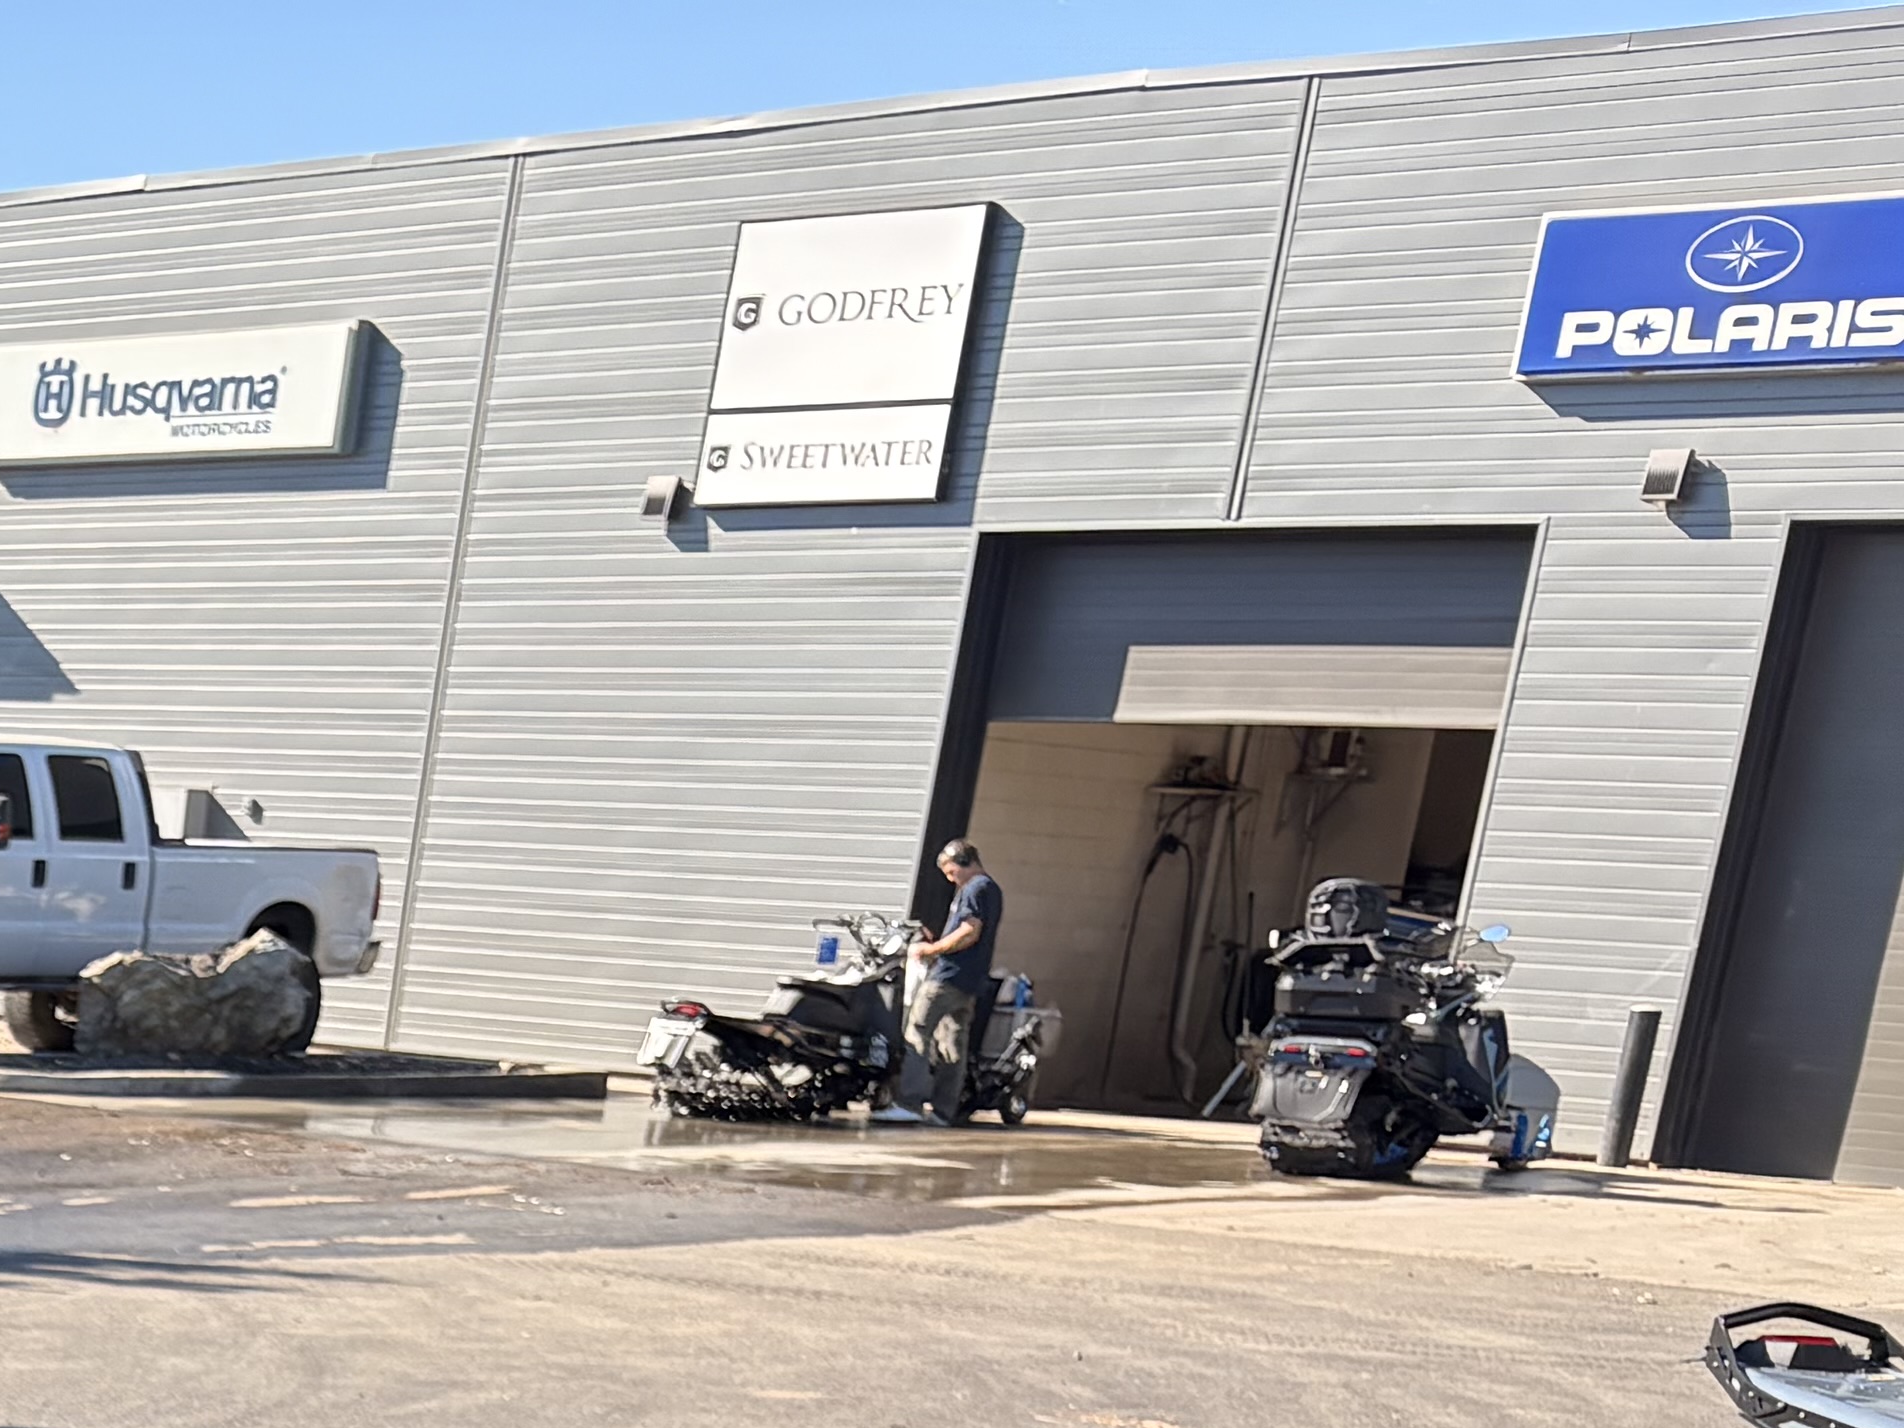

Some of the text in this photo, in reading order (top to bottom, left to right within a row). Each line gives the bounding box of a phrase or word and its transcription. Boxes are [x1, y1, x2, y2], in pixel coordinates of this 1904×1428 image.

[778, 283, 964, 326] GODFREY
[1554, 297, 1904, 358] POLARIS
[80, 373, 278, 422] Husqvarna
[740, 439, 933, 471] SWEETWATER
